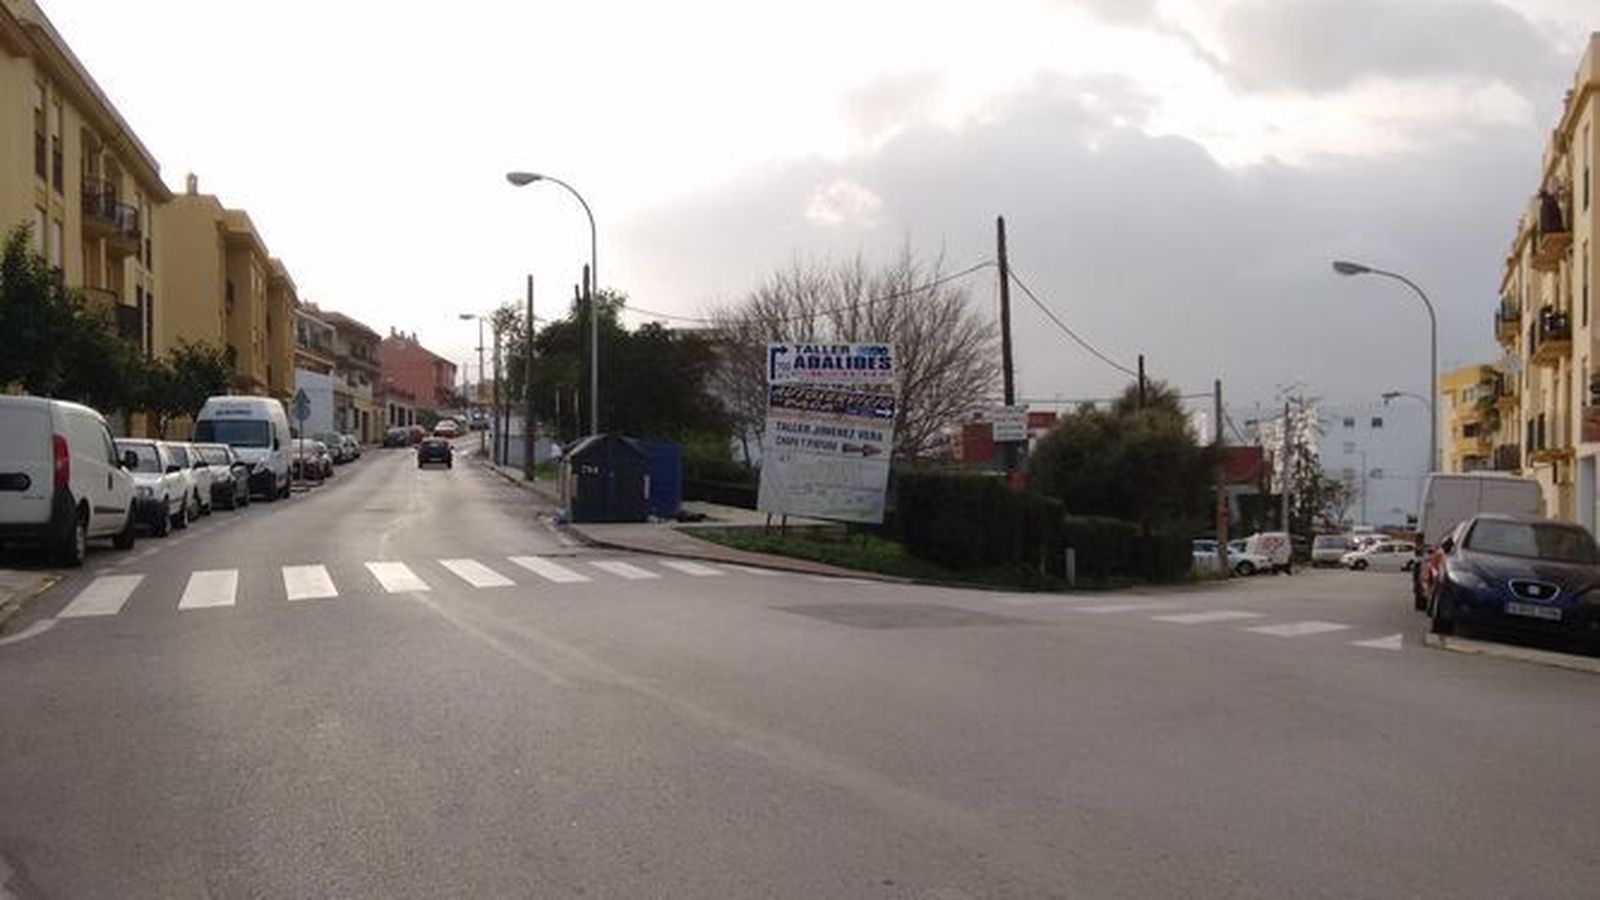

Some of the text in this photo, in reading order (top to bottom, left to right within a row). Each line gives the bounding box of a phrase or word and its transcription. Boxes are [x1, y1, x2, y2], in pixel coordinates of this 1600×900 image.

[794, 345, 850, 354] TALLER
[793, 355, 892, 370] ADALIDES
[776, 421, 811, 434] TALLER
